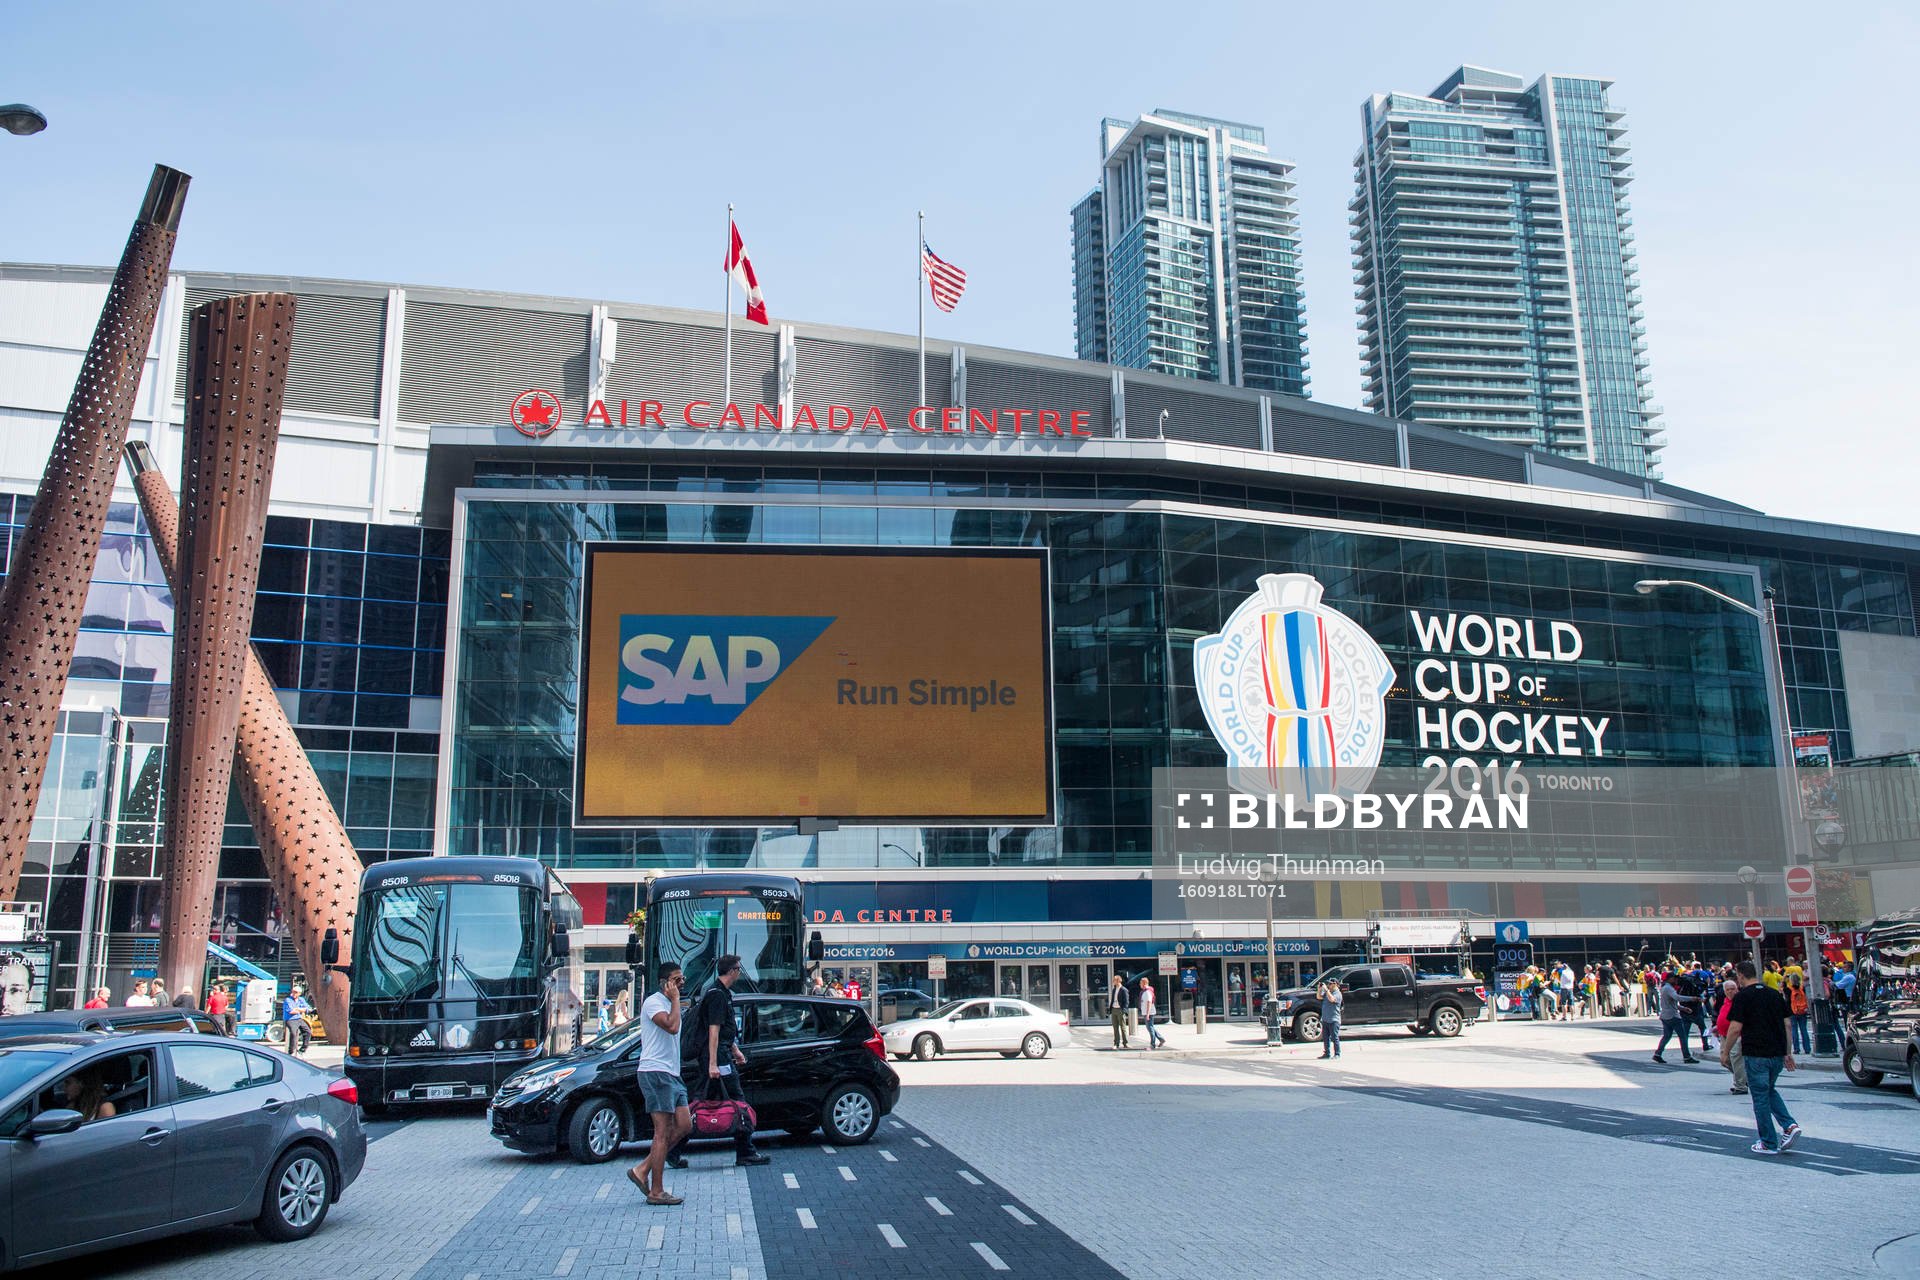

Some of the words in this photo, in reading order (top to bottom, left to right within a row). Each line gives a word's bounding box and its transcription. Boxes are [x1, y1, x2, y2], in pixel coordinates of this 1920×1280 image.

[583, 398, 666, 427] AIR
[683, 400, 890, 432] CANADA
[907, 405, 1093, 438] CENTRE
[1410, 610, 1583, 662] WORLD
[1220, 633, 1243, 677] CUP
[620, 633, 781, 706] SAP
[1331, 628, 1374, 721] HOCKEY
[1414, 658, 1511, 704] CUP
[1517, 675, 1547, 697] OF
[837, 679, 898, 706] Run
[908, 679, 1017, 712] Simple
[1219, 683, 1262, 767] WORLD
[1417, 706, 1610, 757] HOCKEY
[1340, 719, 1372, 765] 2016
[1422, 755, 1531, 802] 2016
[1536, 774, 1614, 792] TORONTO
[382, 876, 408, 887] 85018
[493, 874, 520, 884] 85018
[664, 890, 690, 899] 85033
[762, 889, 788, 897] 85033
[1625, 906, 1656, 918] AIR
[1659, 905, 1729, 917] CANADA
[1789, 900, 1816, 910] WRONG
[737, 911, 781, 920] CHARTERED
[857, 909, 953, 923] CENTRE
[1796, 913, 1811, 923] WAY
[984, 946, 1025, 956] WORLD
[1025, 946, 1048, 956] CUP
[1188, 943, 1224, 953] WORLD
[1225, 944, 1244, 953] CUP
[8, 957, 50, 966] TRAITOR
